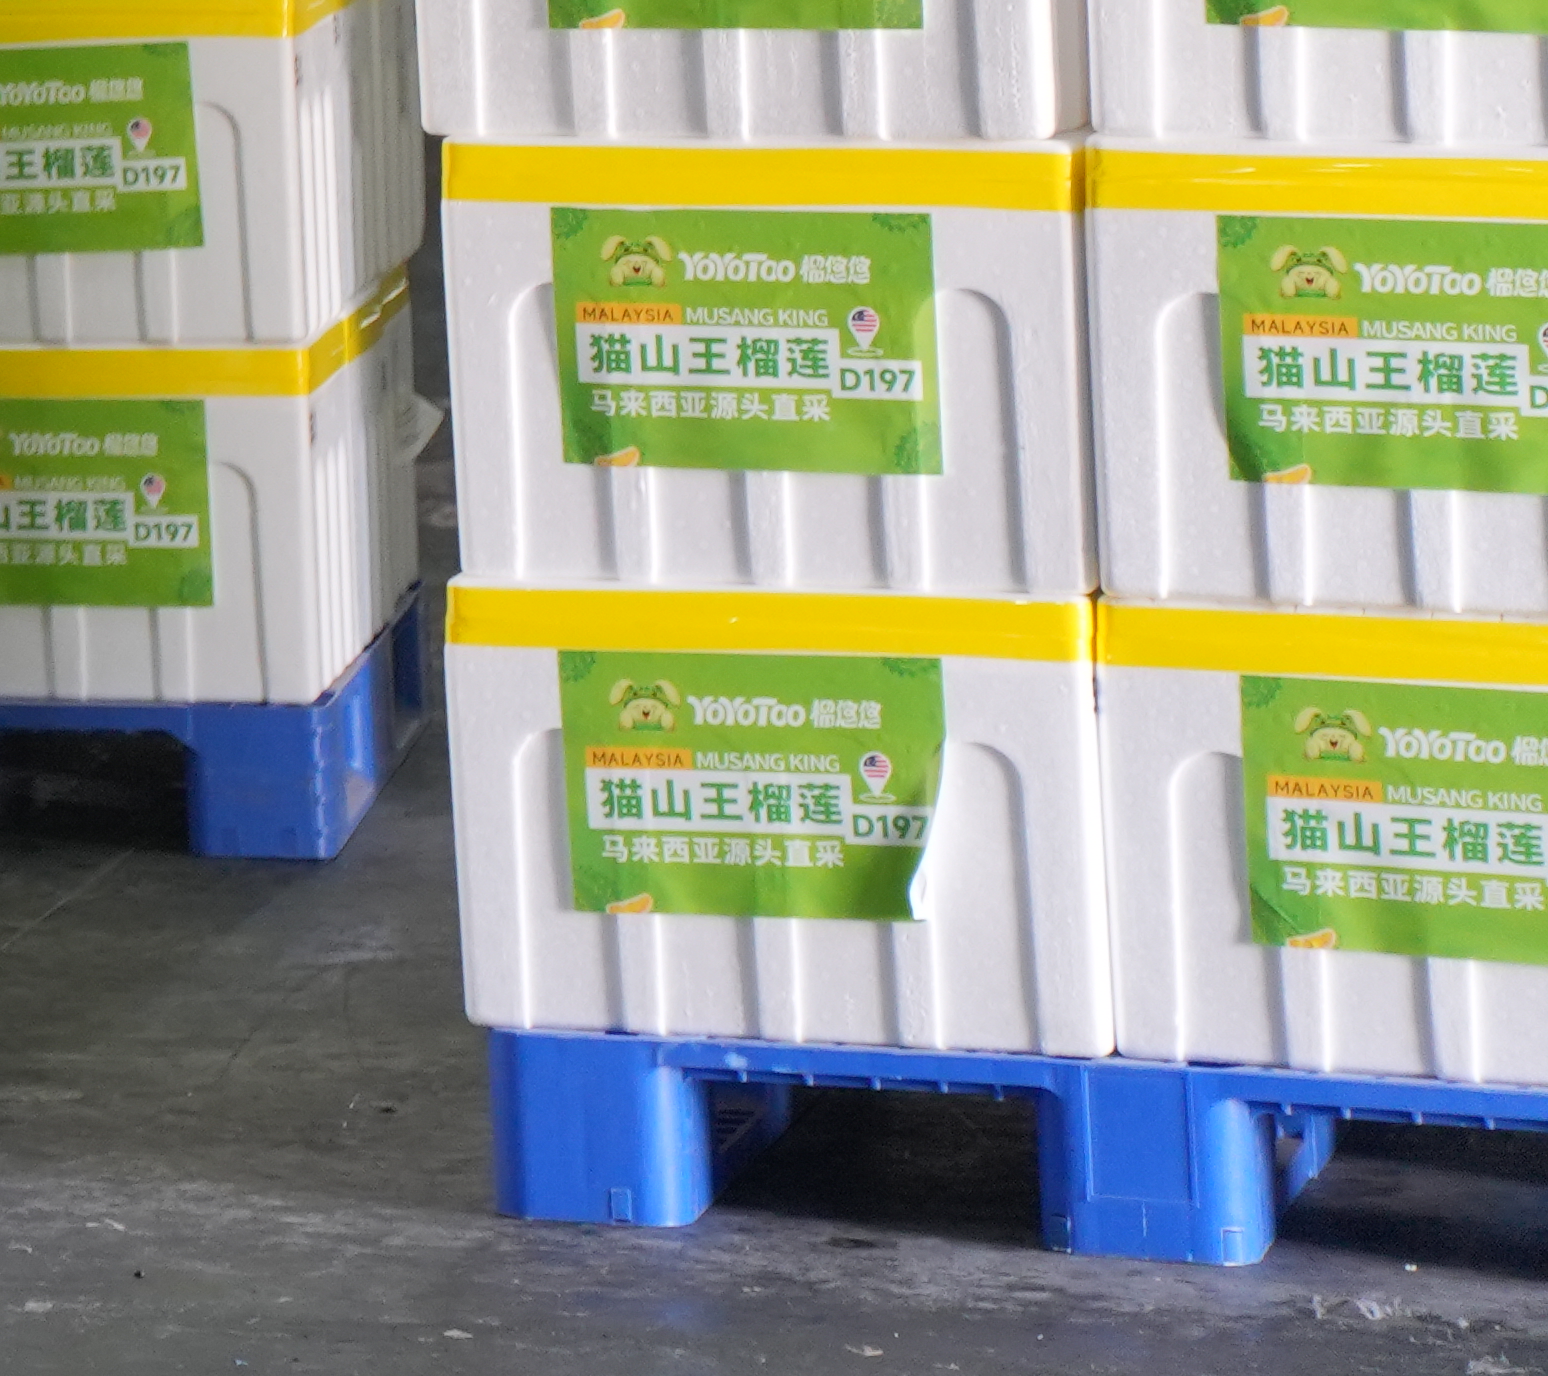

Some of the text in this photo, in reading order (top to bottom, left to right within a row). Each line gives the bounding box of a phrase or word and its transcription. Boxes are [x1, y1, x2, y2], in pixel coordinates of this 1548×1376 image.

[121, 165, 181, 188] D197
[581, 305, 828, 329] MALAYSIA MUSANG KING
[1250, 318, 1517, 345] MALAYSIA MUSANG KING
[589, 333, 830, 379] 猫山王榴莲
[1258, 346, 1518, 396] 猫山王榴莲
[839, 367, 915, 392] D197
[594, 389, 833, 421] 马来西亚源头直采
[1258, 402, 1520, 440] 马来西亚源头直采
[133, 521, 193, 542] D197
[591, 750, 840, 775] MALAYSIA MUSANG KING
[601, 778, 842, 825] 猫山王榴莲
[1274, 777, 1542, 815] MALAYSIA MUSANG KING
[853, 814, 928, 842] D197
[1279, 809, 1544, 869] 猫山王榴莲
[602, 833, 847, 867] 马来西亚源头直采
[1282, 865, 1545, 910] 马来西亚源头直采
